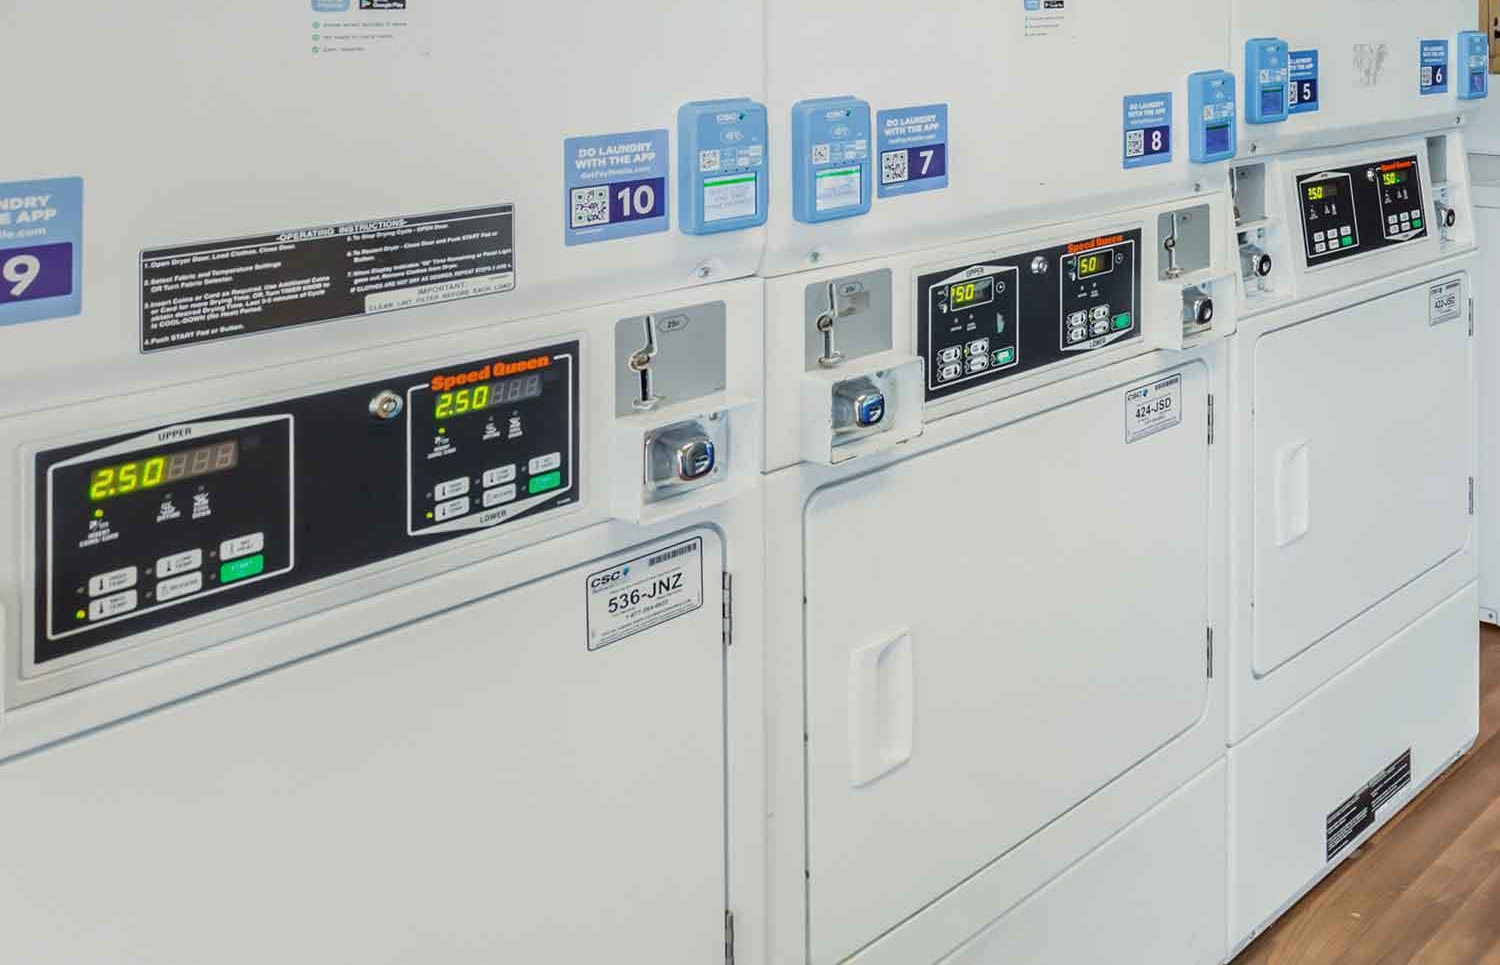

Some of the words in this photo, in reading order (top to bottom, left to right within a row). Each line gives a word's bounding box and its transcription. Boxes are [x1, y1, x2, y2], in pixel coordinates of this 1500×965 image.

[1435, 67, 1442, 84] 6
[1303, 83, 1311, 100] 5
[578, 147, 597, 157] DO
[599, 141, 652, 156] LAUNDRY
[1152, 130, 1161, 151] 8
[575, 158, 608, 169] WITH
[609, 155, 632, 165] THE
[633, 152, 656, 163] APP
[920, 150, 933, 175] 7
[618, 185, 655, 216] 10
[16, 208, 57, 224] APP
[1067, 238, 1095, 253] Speed
[3, 254, 41, 296] 9
[431, 365, 491, 390] Speed
[493, 355, 550, 376] Queen
[434, 385, 489, 418] 2.50
[1136, 397, 1171, 418] 424-JSD
[158, 427, 192, 441] UPPER
[89, 456, 165, 501] 2.50
[479, 510, 507, 523] LOWER
[591, 571, 620, 588] CSC
[608, 572, 683, 614] 536-JNZ
